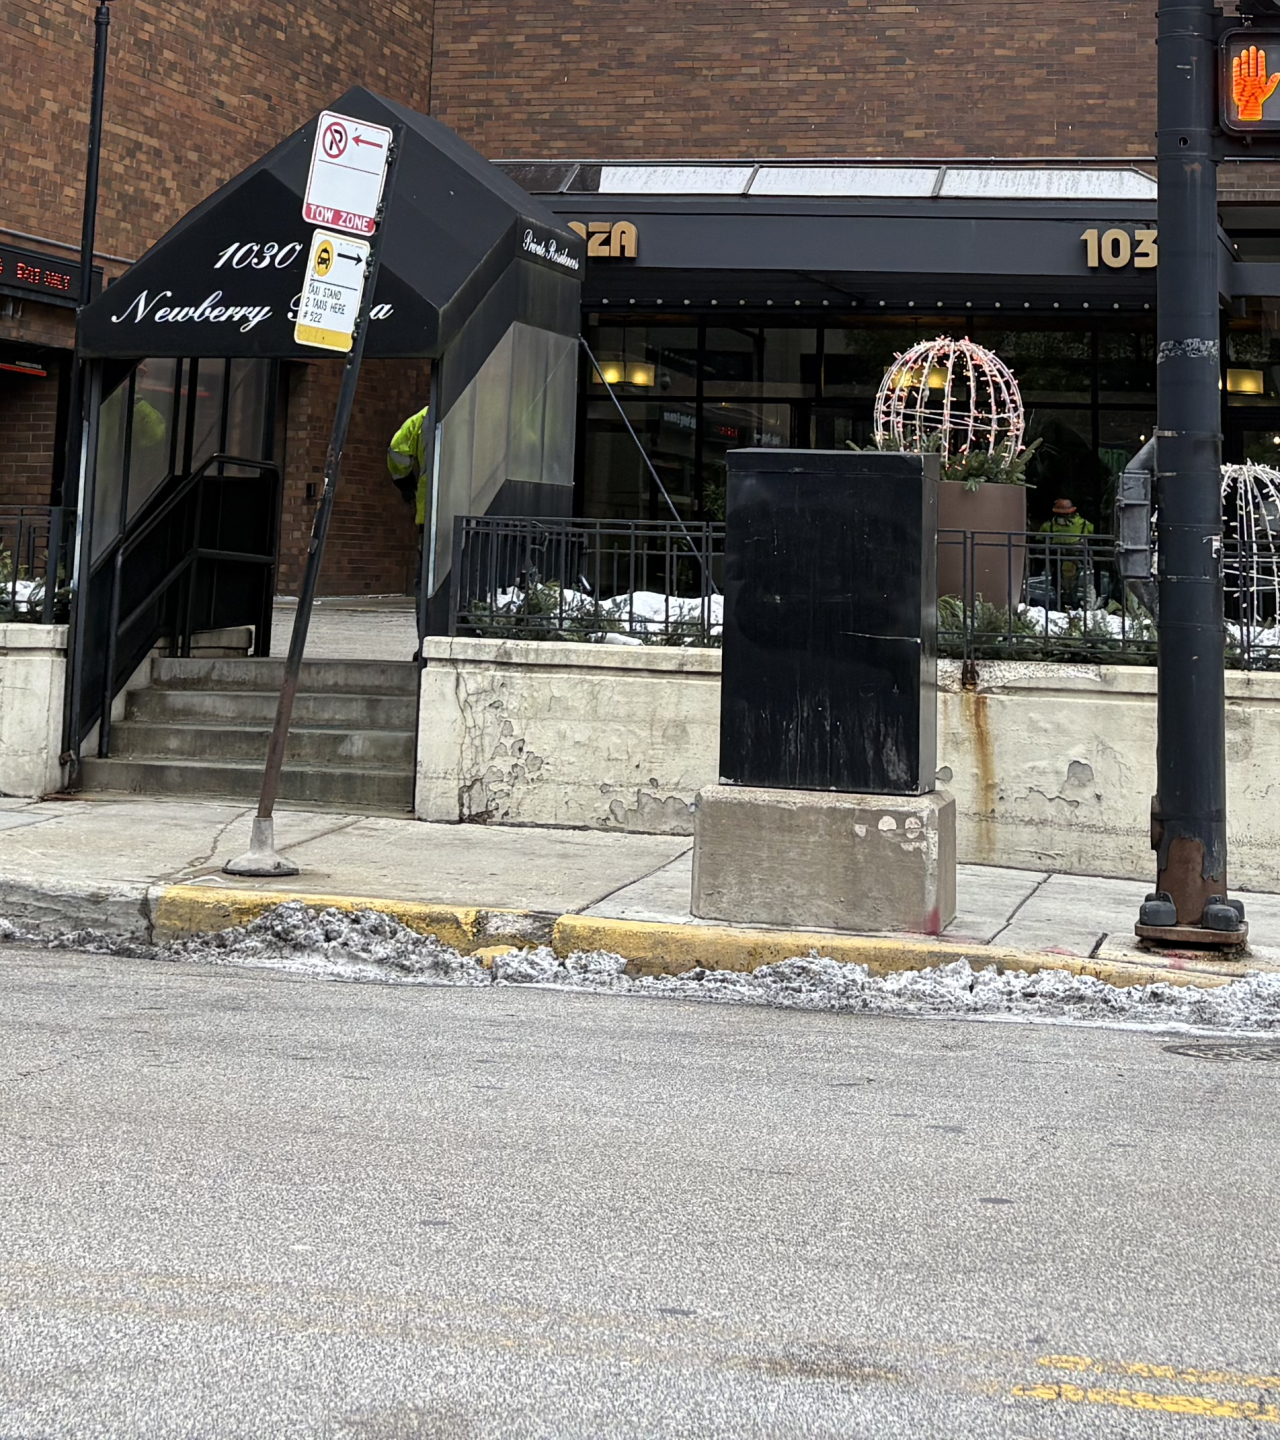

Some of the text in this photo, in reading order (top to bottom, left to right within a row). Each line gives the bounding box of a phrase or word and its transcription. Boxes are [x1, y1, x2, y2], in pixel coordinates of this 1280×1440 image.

[309, 205, 370, 231] TOW ZONE
[213, 242, 304, 270] 1030
[308, 282, 342, 301] TAXI STAND
[111, 290, 273, 333] Newberry
[305, 296, 346, 315] 2 TAXIS HERE
[310, 311, 323, 323] 522
